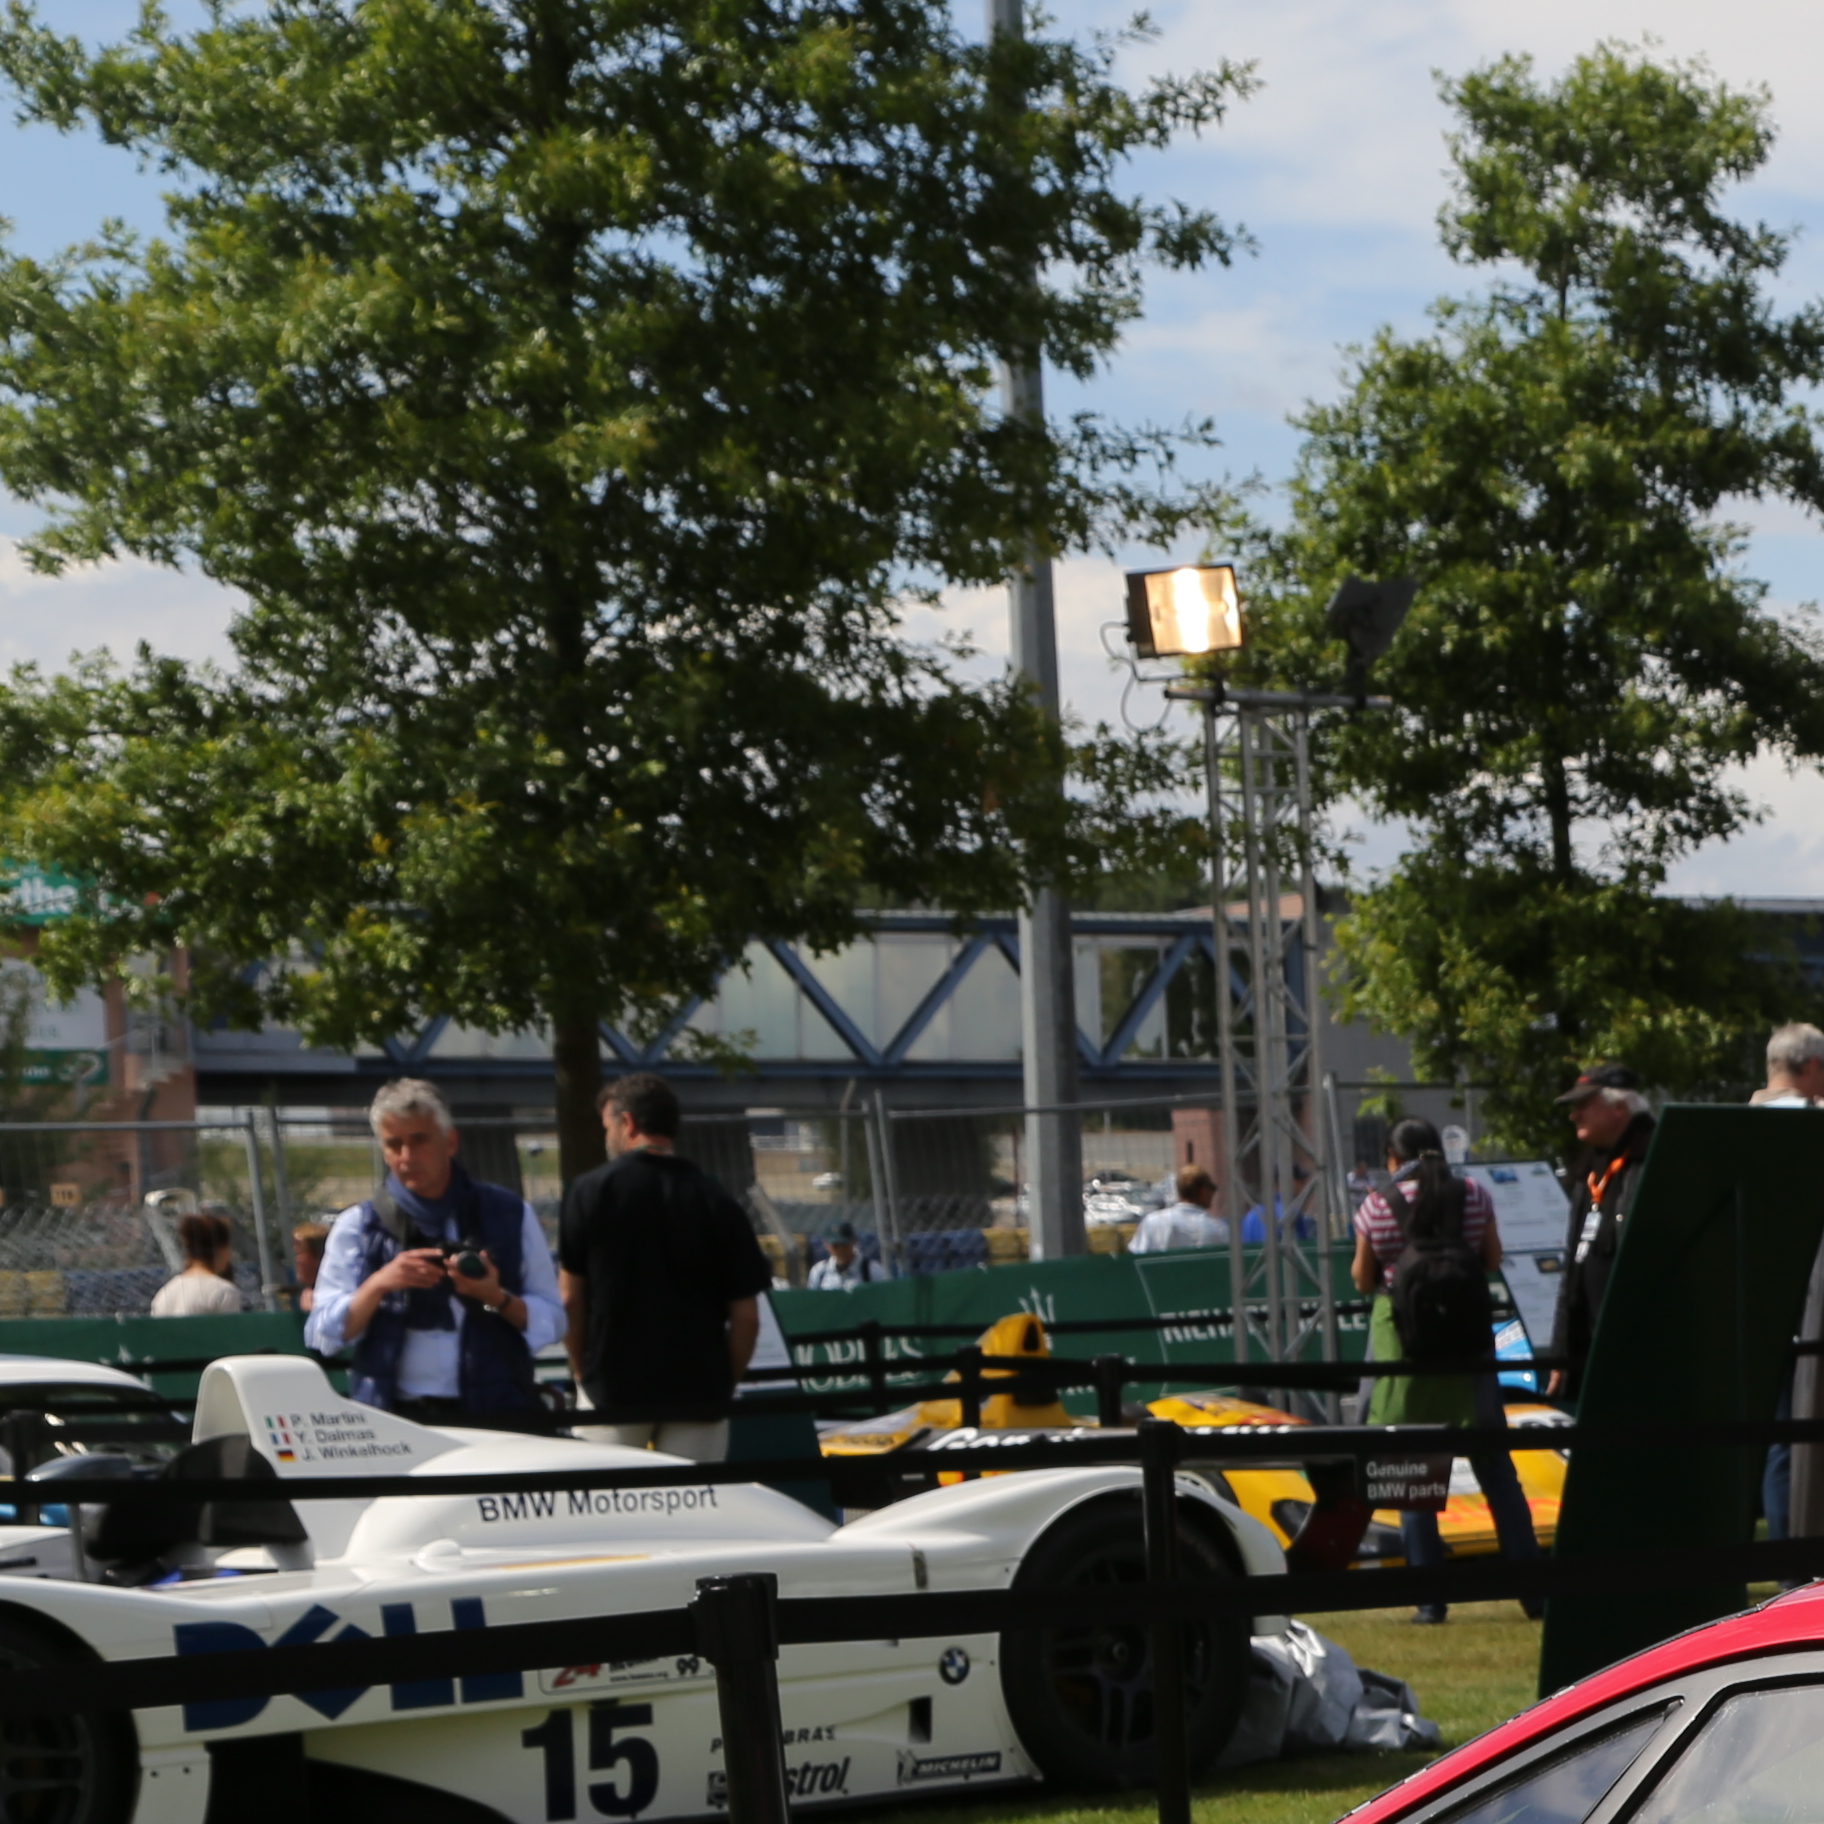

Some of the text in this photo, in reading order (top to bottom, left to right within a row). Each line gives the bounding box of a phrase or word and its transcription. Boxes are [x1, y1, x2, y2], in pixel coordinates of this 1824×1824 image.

[310, 1411, 367, 1426] Martini
[314, 1428, 376, 1443] Dalmas
[318, 1440, 413, 1460] Winkelhock
[1366, 1460, 1428, 1479] Genuine
[1366, 1480, 1447, 1502] BMW parts
[477, 1484, 719, 1522] BMW Motorsport
[522, 1703, 659, 1822] 15
[917, 1755, 999, 1775] MICHELIN
